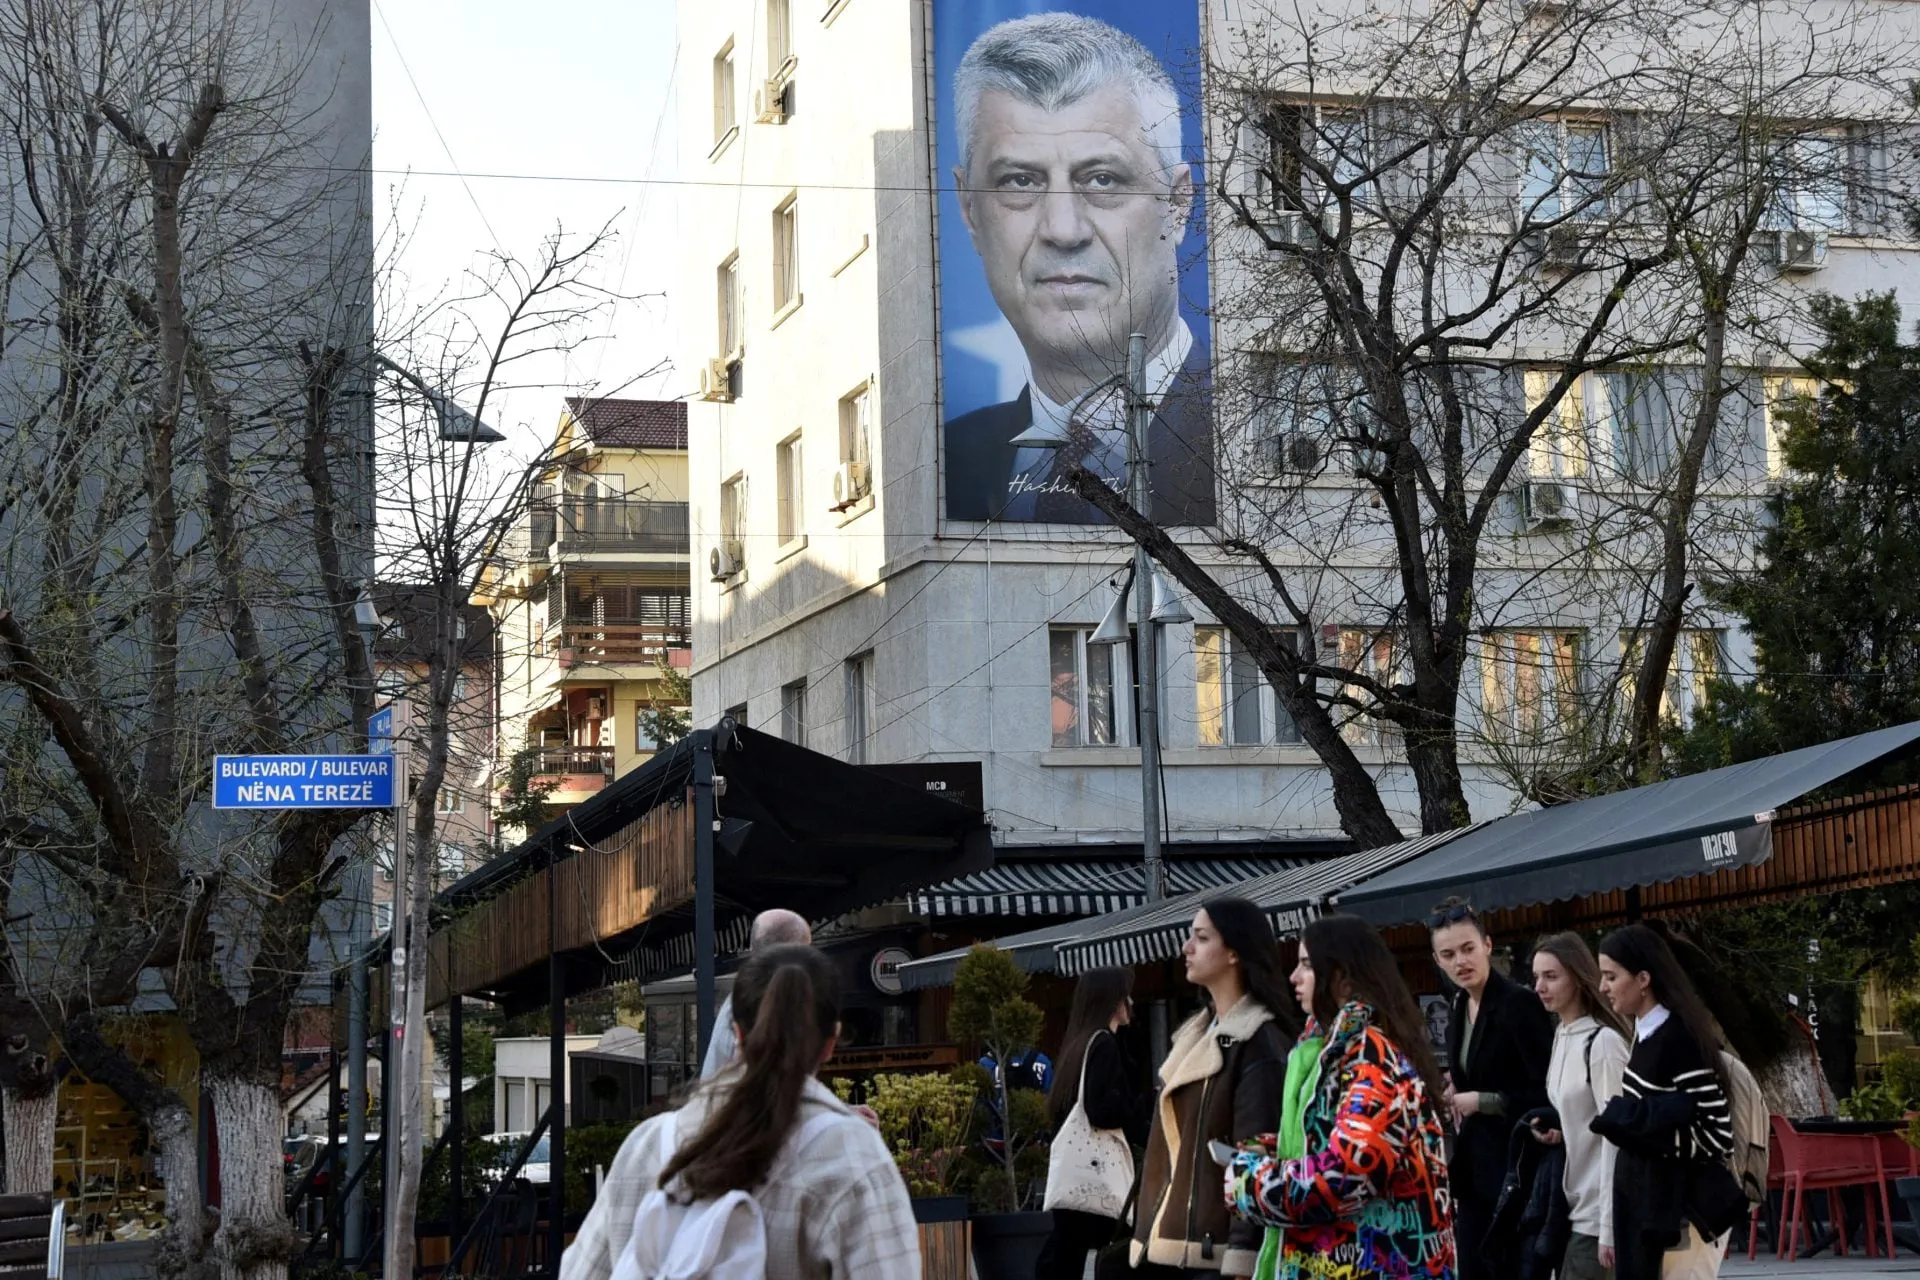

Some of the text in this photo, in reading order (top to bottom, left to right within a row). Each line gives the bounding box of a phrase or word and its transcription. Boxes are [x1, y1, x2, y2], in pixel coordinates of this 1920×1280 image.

[222, 760, 388, 779] BULEVARDI / BULEVAR
[238, 781, 373, 801] NËNA TEREZË
[1701, 831, 1737, 860] margo
